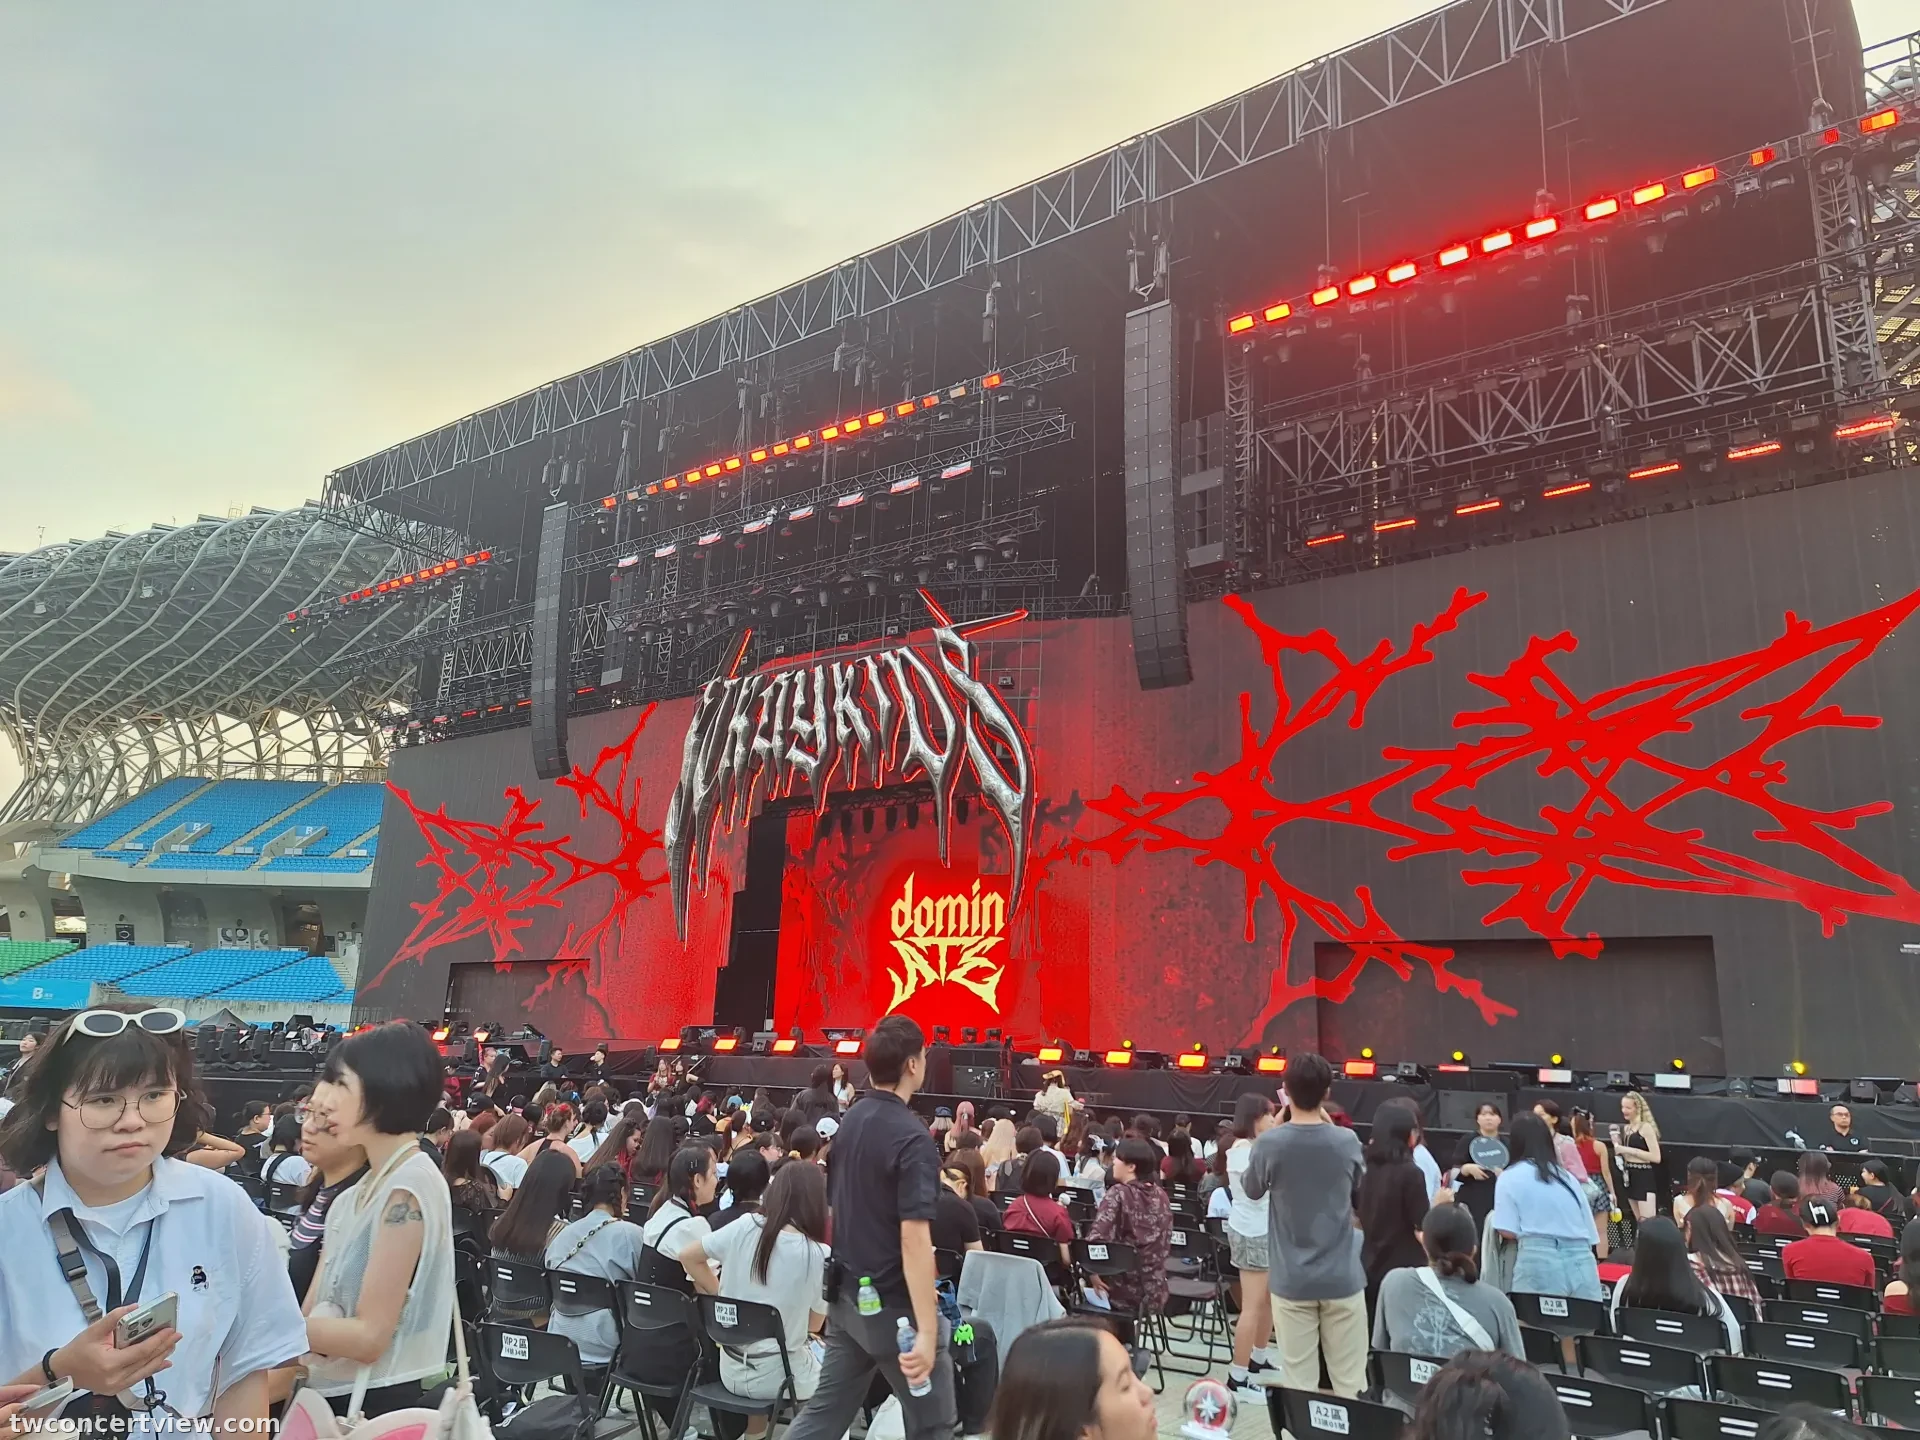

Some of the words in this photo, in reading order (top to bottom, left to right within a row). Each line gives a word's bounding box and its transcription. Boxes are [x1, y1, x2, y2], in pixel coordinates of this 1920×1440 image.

[891, 871, 1005, 939] domin
[32, 987, 44, 1000] B
[885, 935, 1005, 1016] ATE
